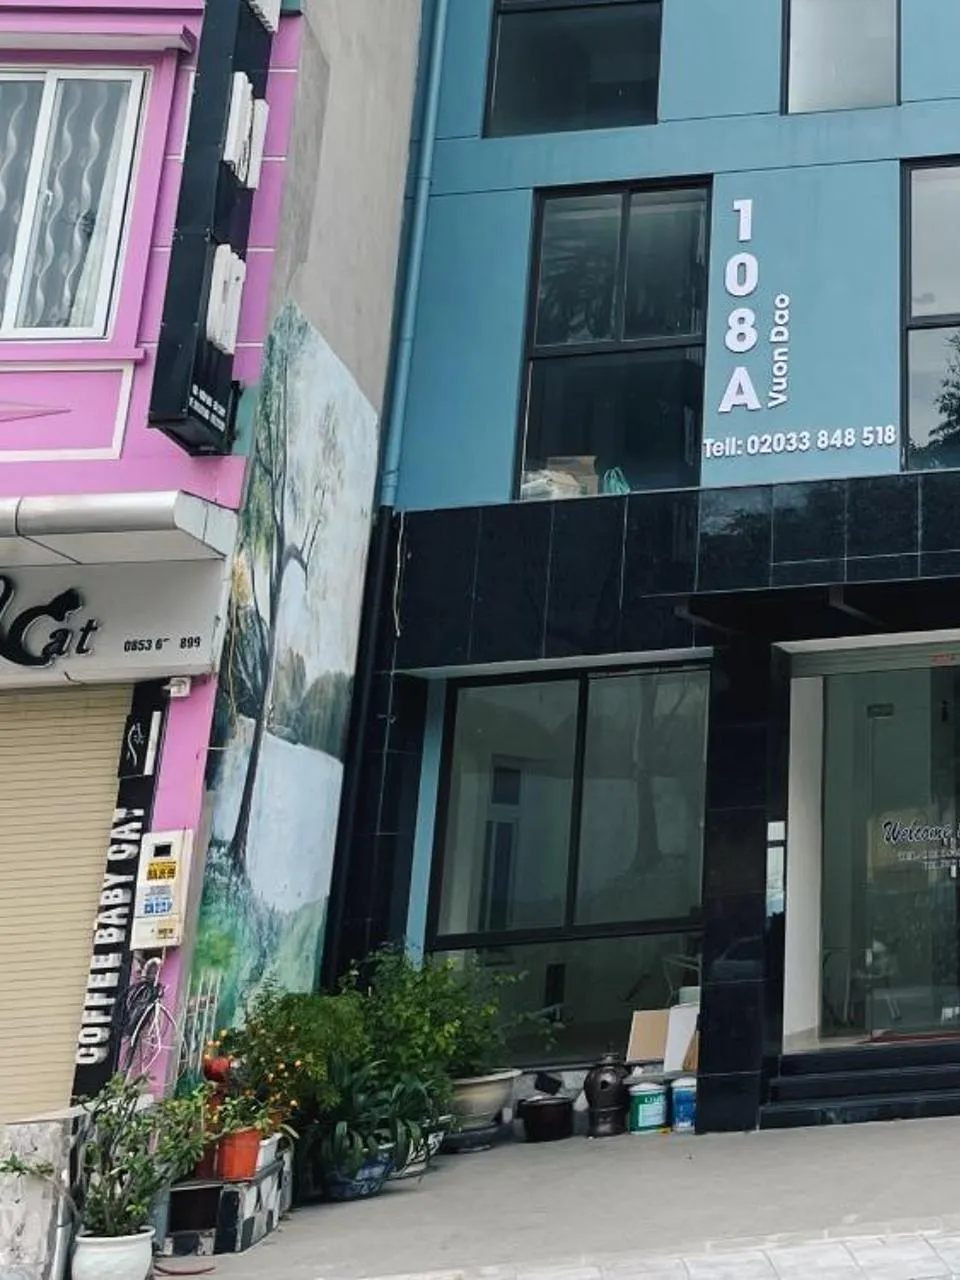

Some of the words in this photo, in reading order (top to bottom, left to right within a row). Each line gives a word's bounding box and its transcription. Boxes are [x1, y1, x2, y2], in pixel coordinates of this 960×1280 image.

[718, 199, 762, 414] 108A
[769, 293, 790, 343] Dao
[767, 346, 790, 409] Vuon
[702, 437, 744, 459] Tell:
[747, 431, 811, 455] 02033
[817, 426, 857, 451] 848
[862, 424, 897, 448] 518
[179, 636, 201, 650] 899
[107, 805, 144, 861] CAT
[94, 871, 134, 946] BABY
[75, 949, 122, 1066] COFFEE
